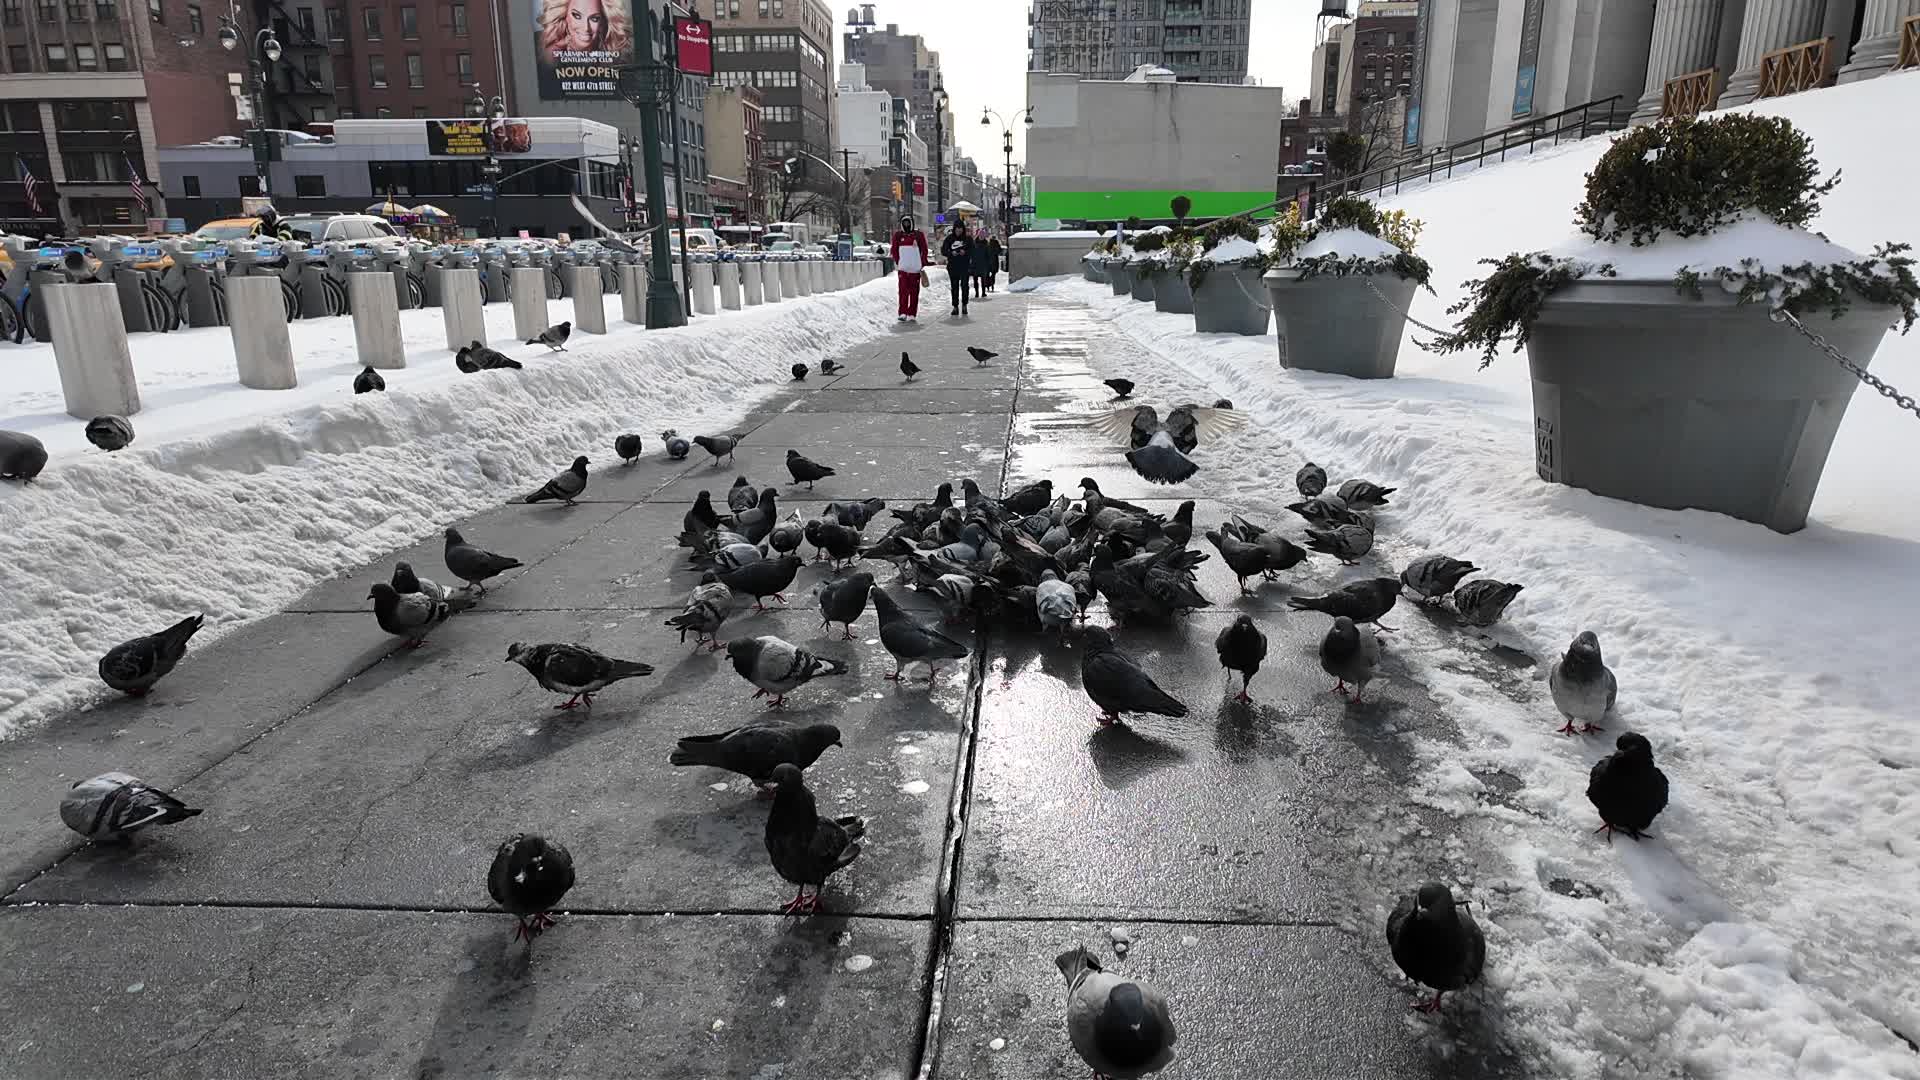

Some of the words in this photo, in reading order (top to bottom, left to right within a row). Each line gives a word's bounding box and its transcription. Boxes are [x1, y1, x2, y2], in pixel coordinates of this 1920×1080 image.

[687, 35, 709, 45] Stopping
[556, 66, 585, 79] NOW
[588, 66, 620, 79] OPEN
[572, 82, 586, 90] WEST
